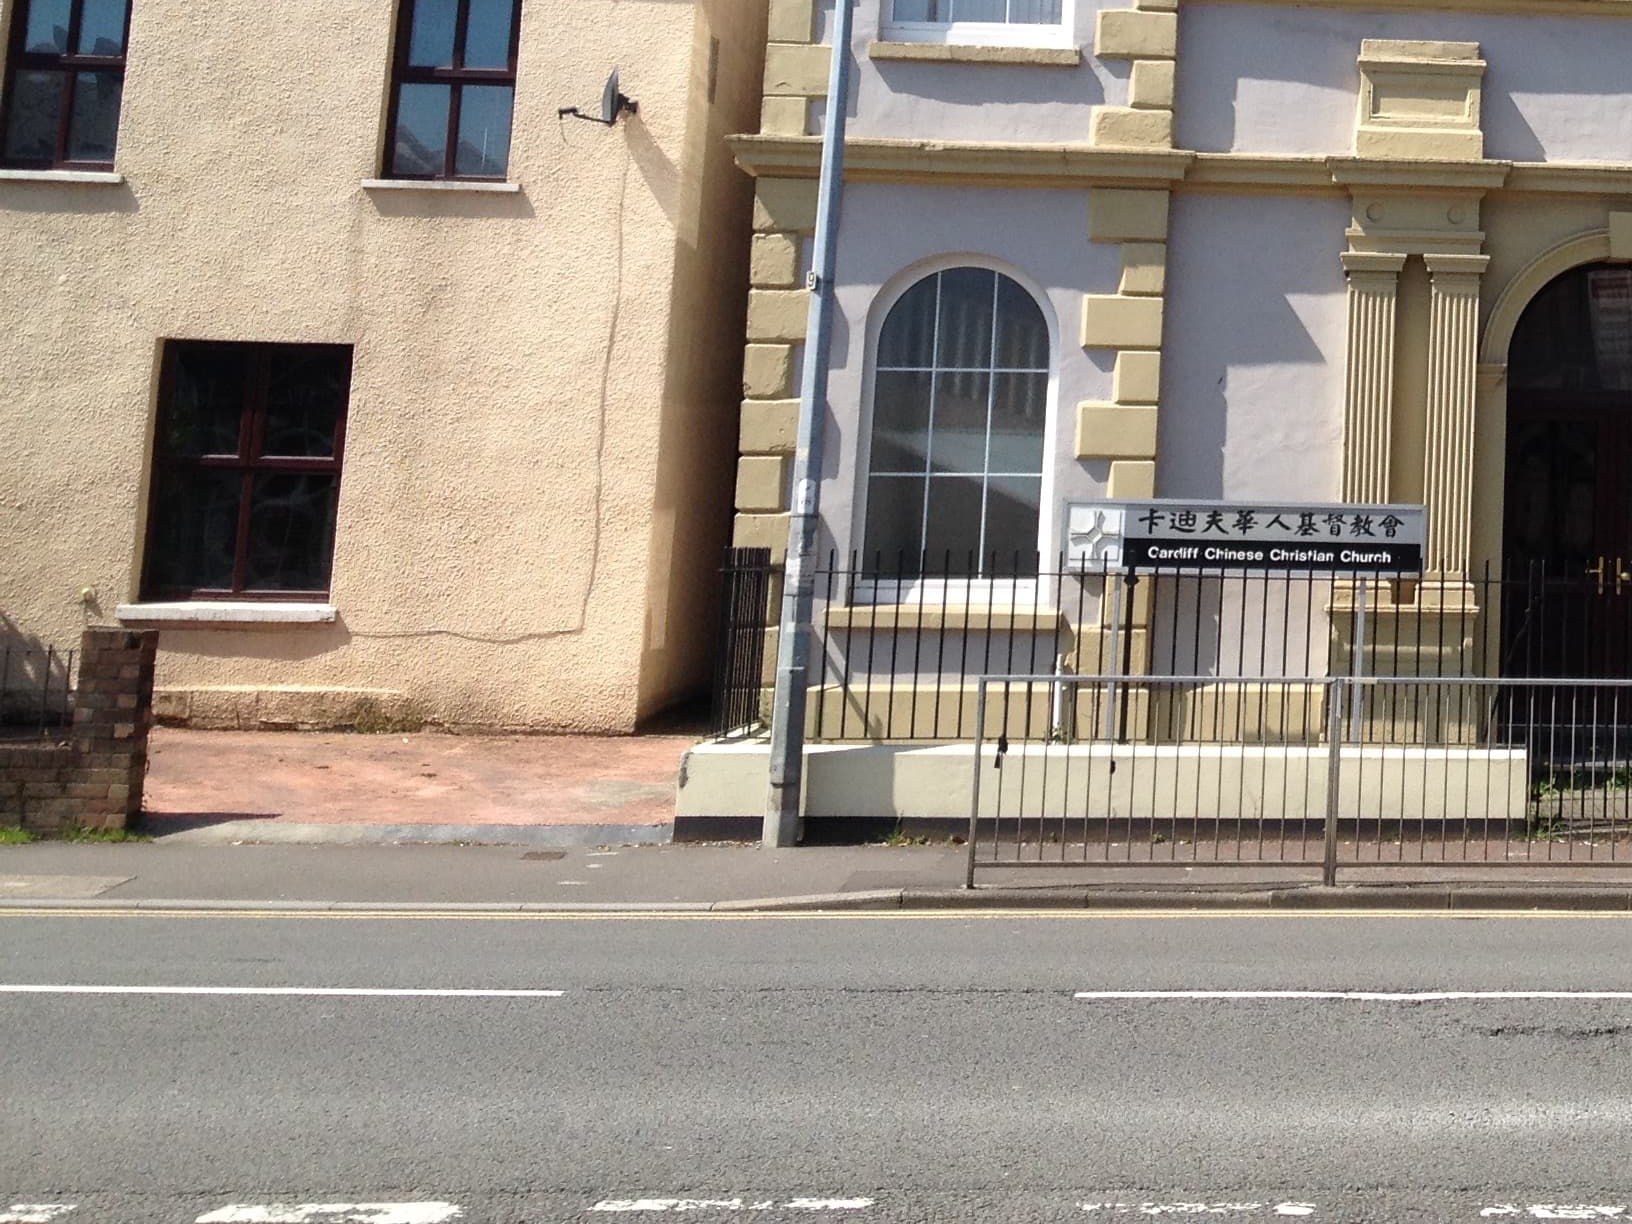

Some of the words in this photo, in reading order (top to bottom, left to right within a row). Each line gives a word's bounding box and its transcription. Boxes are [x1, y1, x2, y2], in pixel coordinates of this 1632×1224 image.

[1137, 508, 1405, 537] 卡迪夫華人基督教會
[1147, 545, 1199, 560] Cardiff
[1204, 546, 1264, 561] Chinese
[1269, 548, 1335, 562] Christian
[1340, 549, 1392, 564] Church
